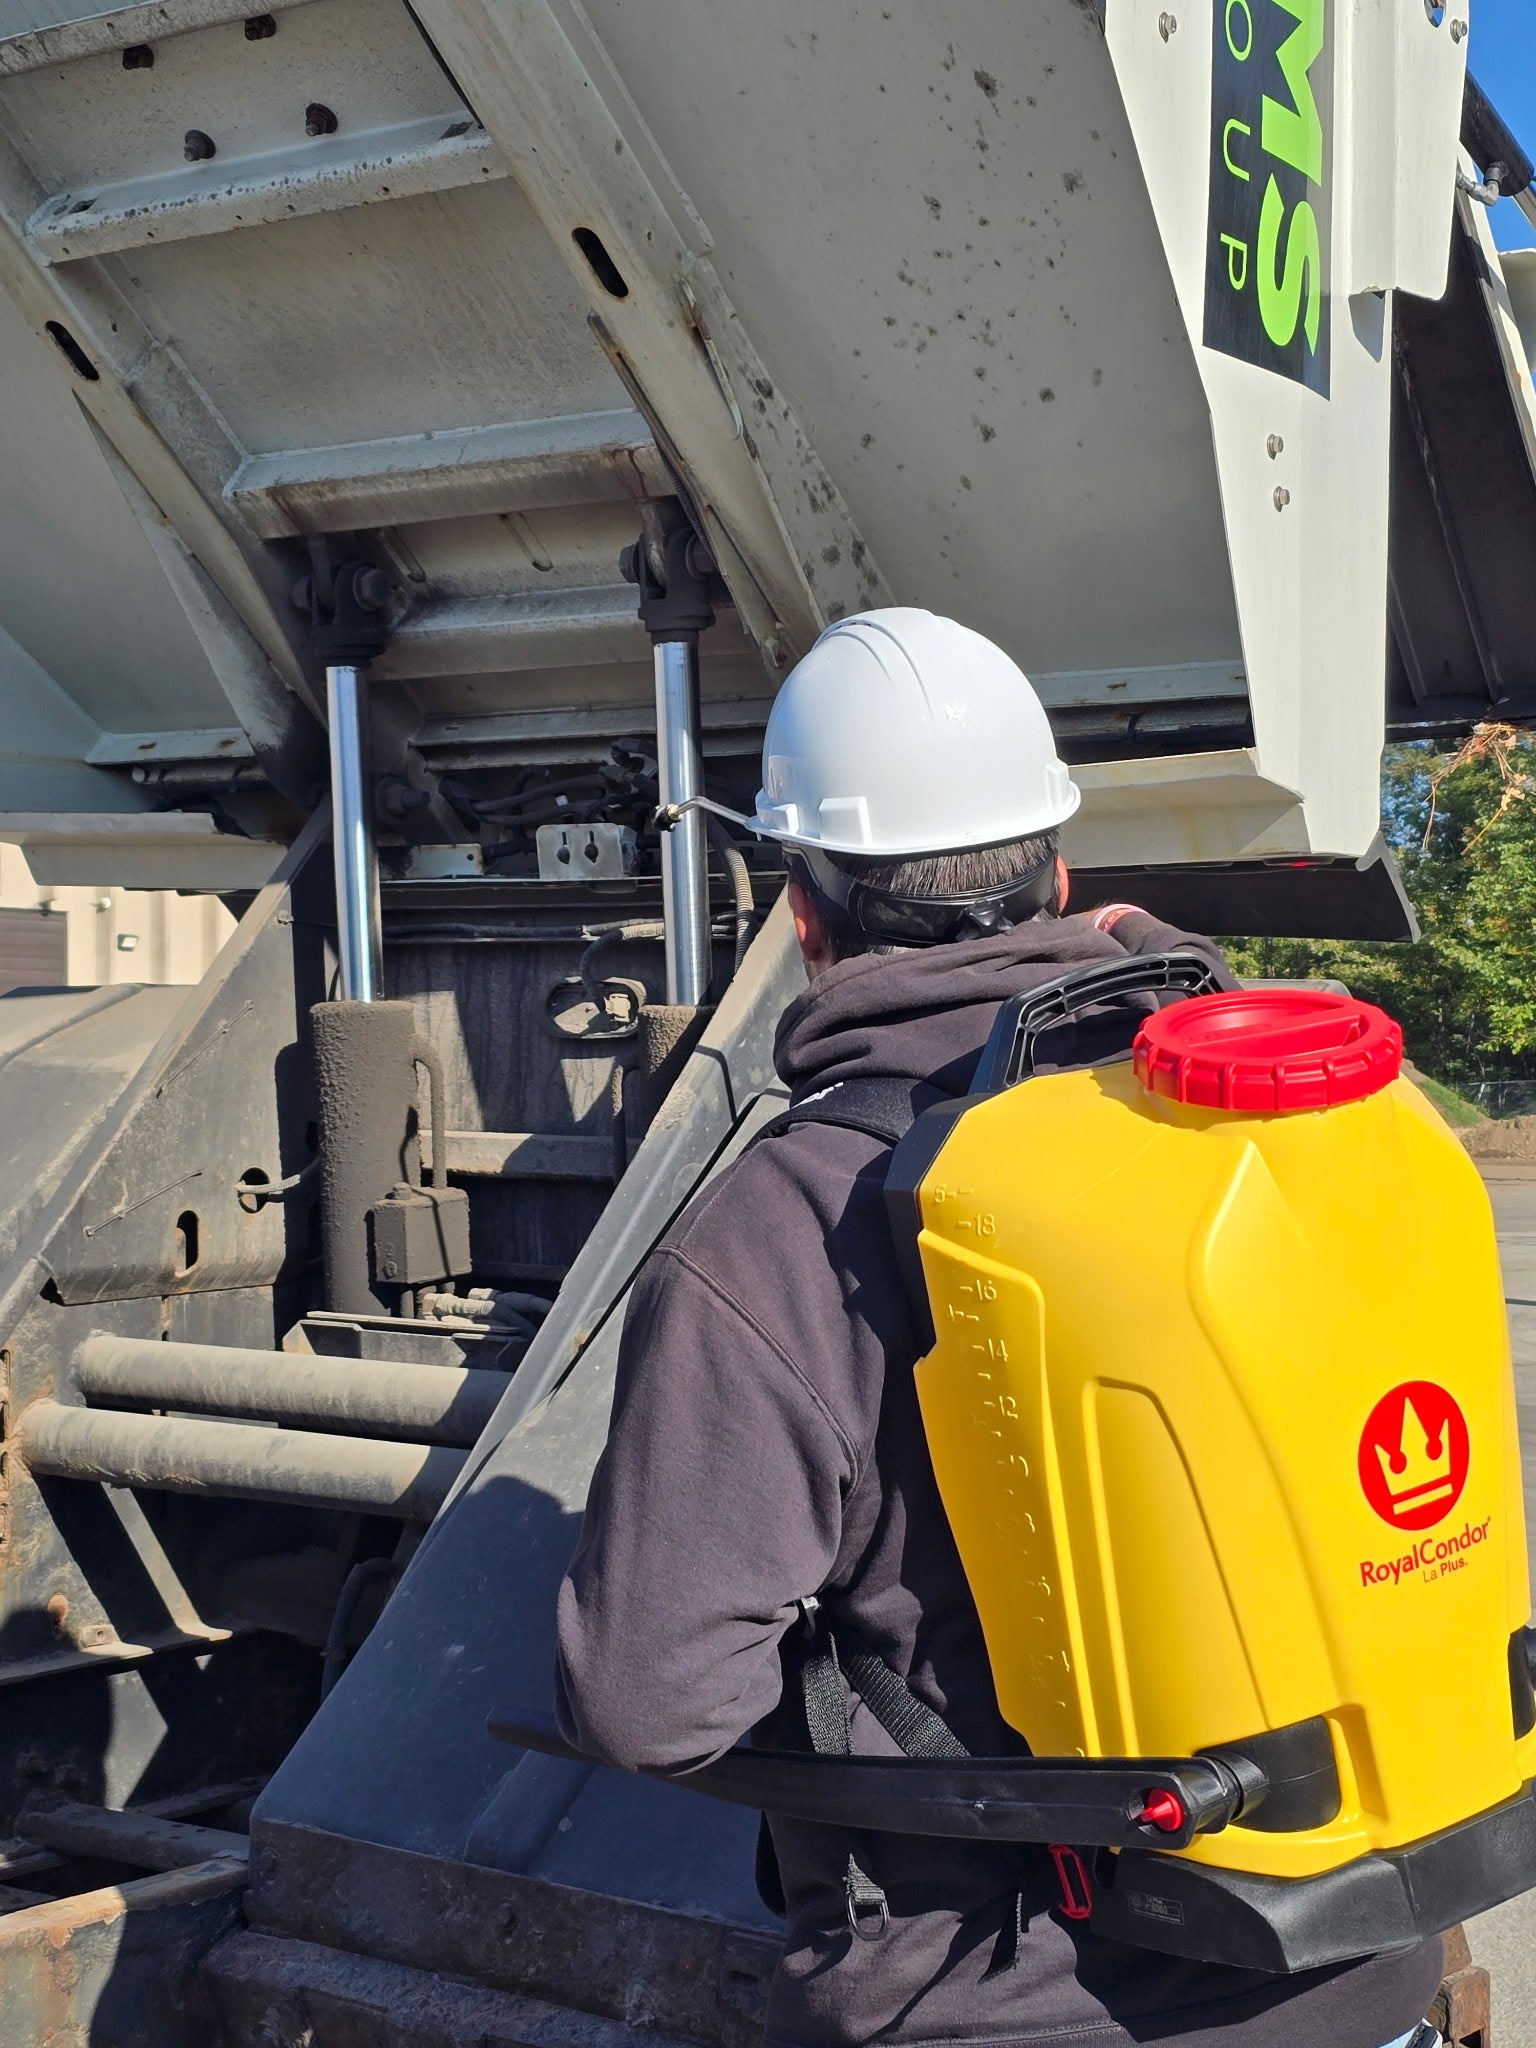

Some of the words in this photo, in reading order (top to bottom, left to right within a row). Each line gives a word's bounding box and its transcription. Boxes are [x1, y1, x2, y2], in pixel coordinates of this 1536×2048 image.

[1257, 0, 1324, 356] MS
[1360, 1520, 1488, 1586] RoyalCondor
[1423, 1569, 1438, 1583] La
